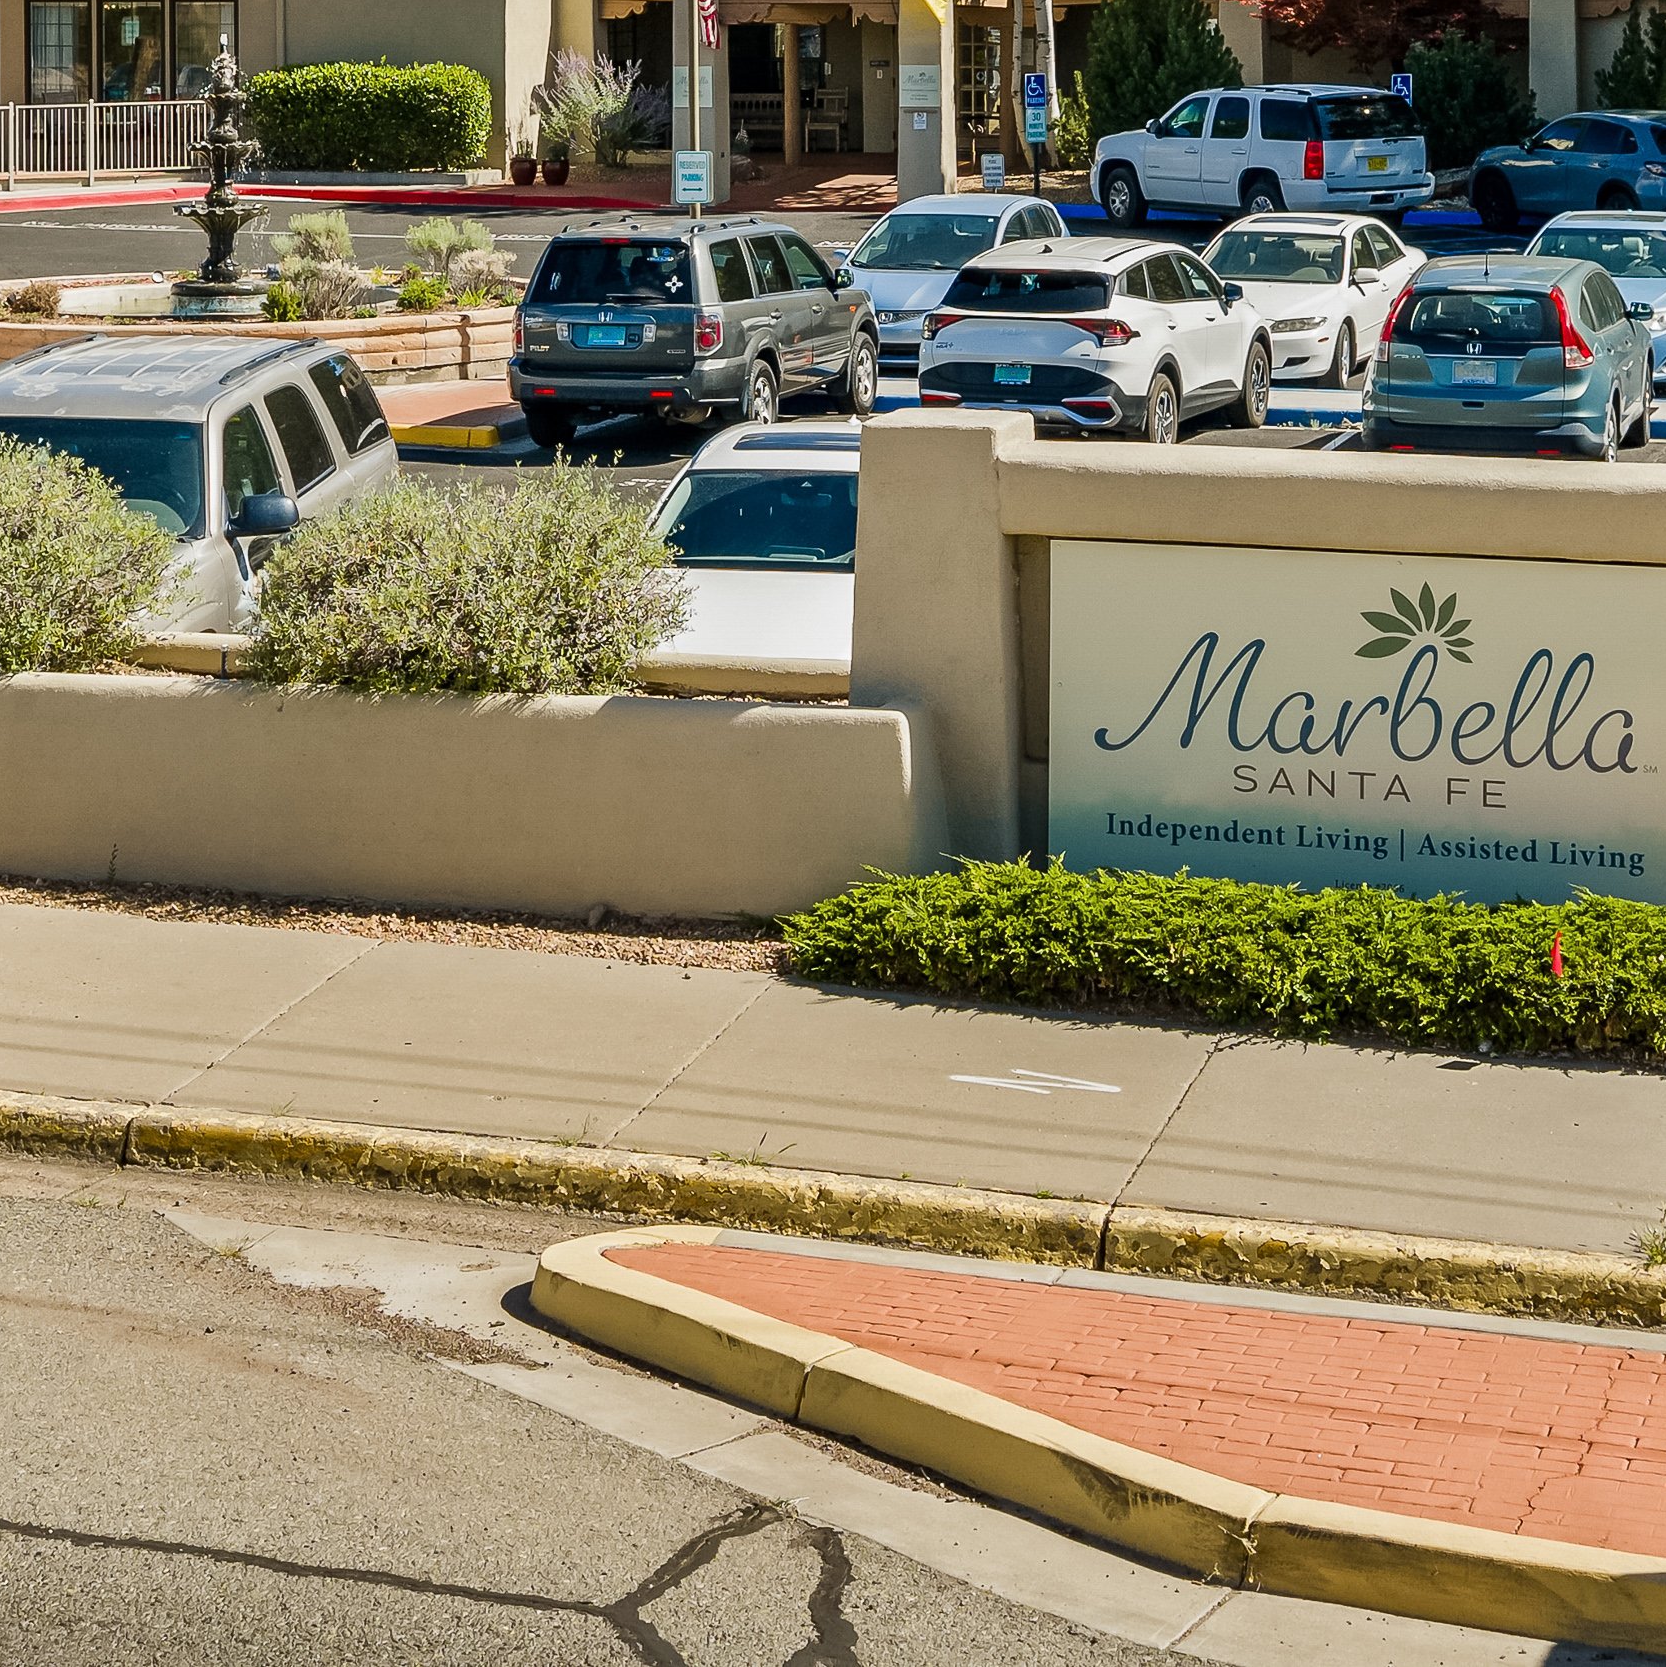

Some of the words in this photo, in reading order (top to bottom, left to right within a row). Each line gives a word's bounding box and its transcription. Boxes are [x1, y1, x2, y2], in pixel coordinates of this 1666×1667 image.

[1031, 112, 1041, 122] 30
[679, 160, 706, 170] RESERVED
[681, 173, 704, 182] PARKING
[1093, 631, 1638, 774] Marbella
[1232, 764, 1412, 803] SANTA
[1446, 777, 1507, 810] FE
[1105, 812, 1286, 847] Independent
[1295, 824, 1389, 861] Living
[1416, 832, 1539, 863] Assisted
[1549, 841, 1646, 877] Living
[1334, 879, 1373, 891] Licene
